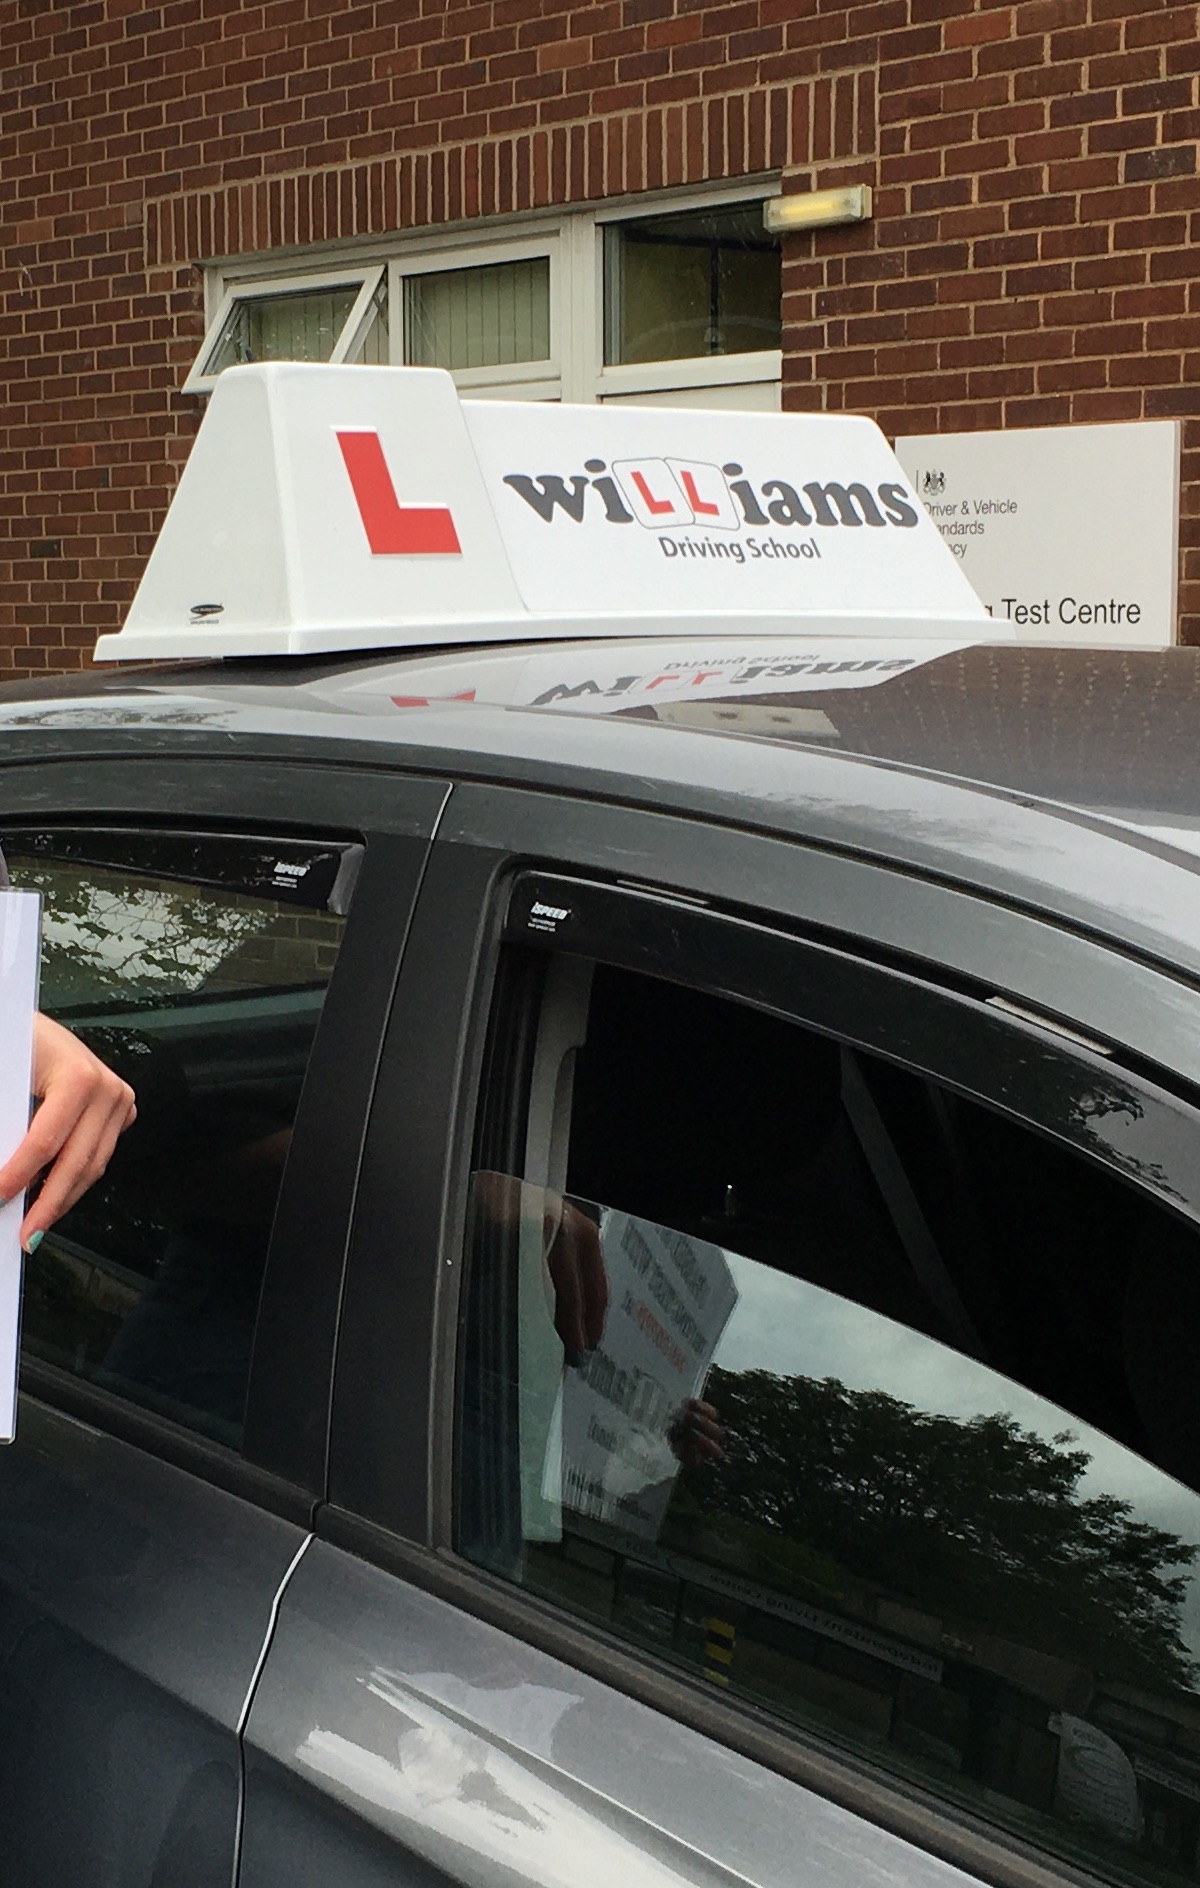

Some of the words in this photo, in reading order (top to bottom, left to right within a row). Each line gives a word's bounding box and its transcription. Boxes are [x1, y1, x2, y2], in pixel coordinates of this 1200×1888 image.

[336, 431, 462, 555] L
[961, 500, 970, 516] &
[973, 499, 1018, 515] Vehicle
[659, 537, 746, 563] Driving
[751, 538, 821, 558] School
[1002, 598, 1051, 625] Test
[1058, 597, 1141, 625] Centre
